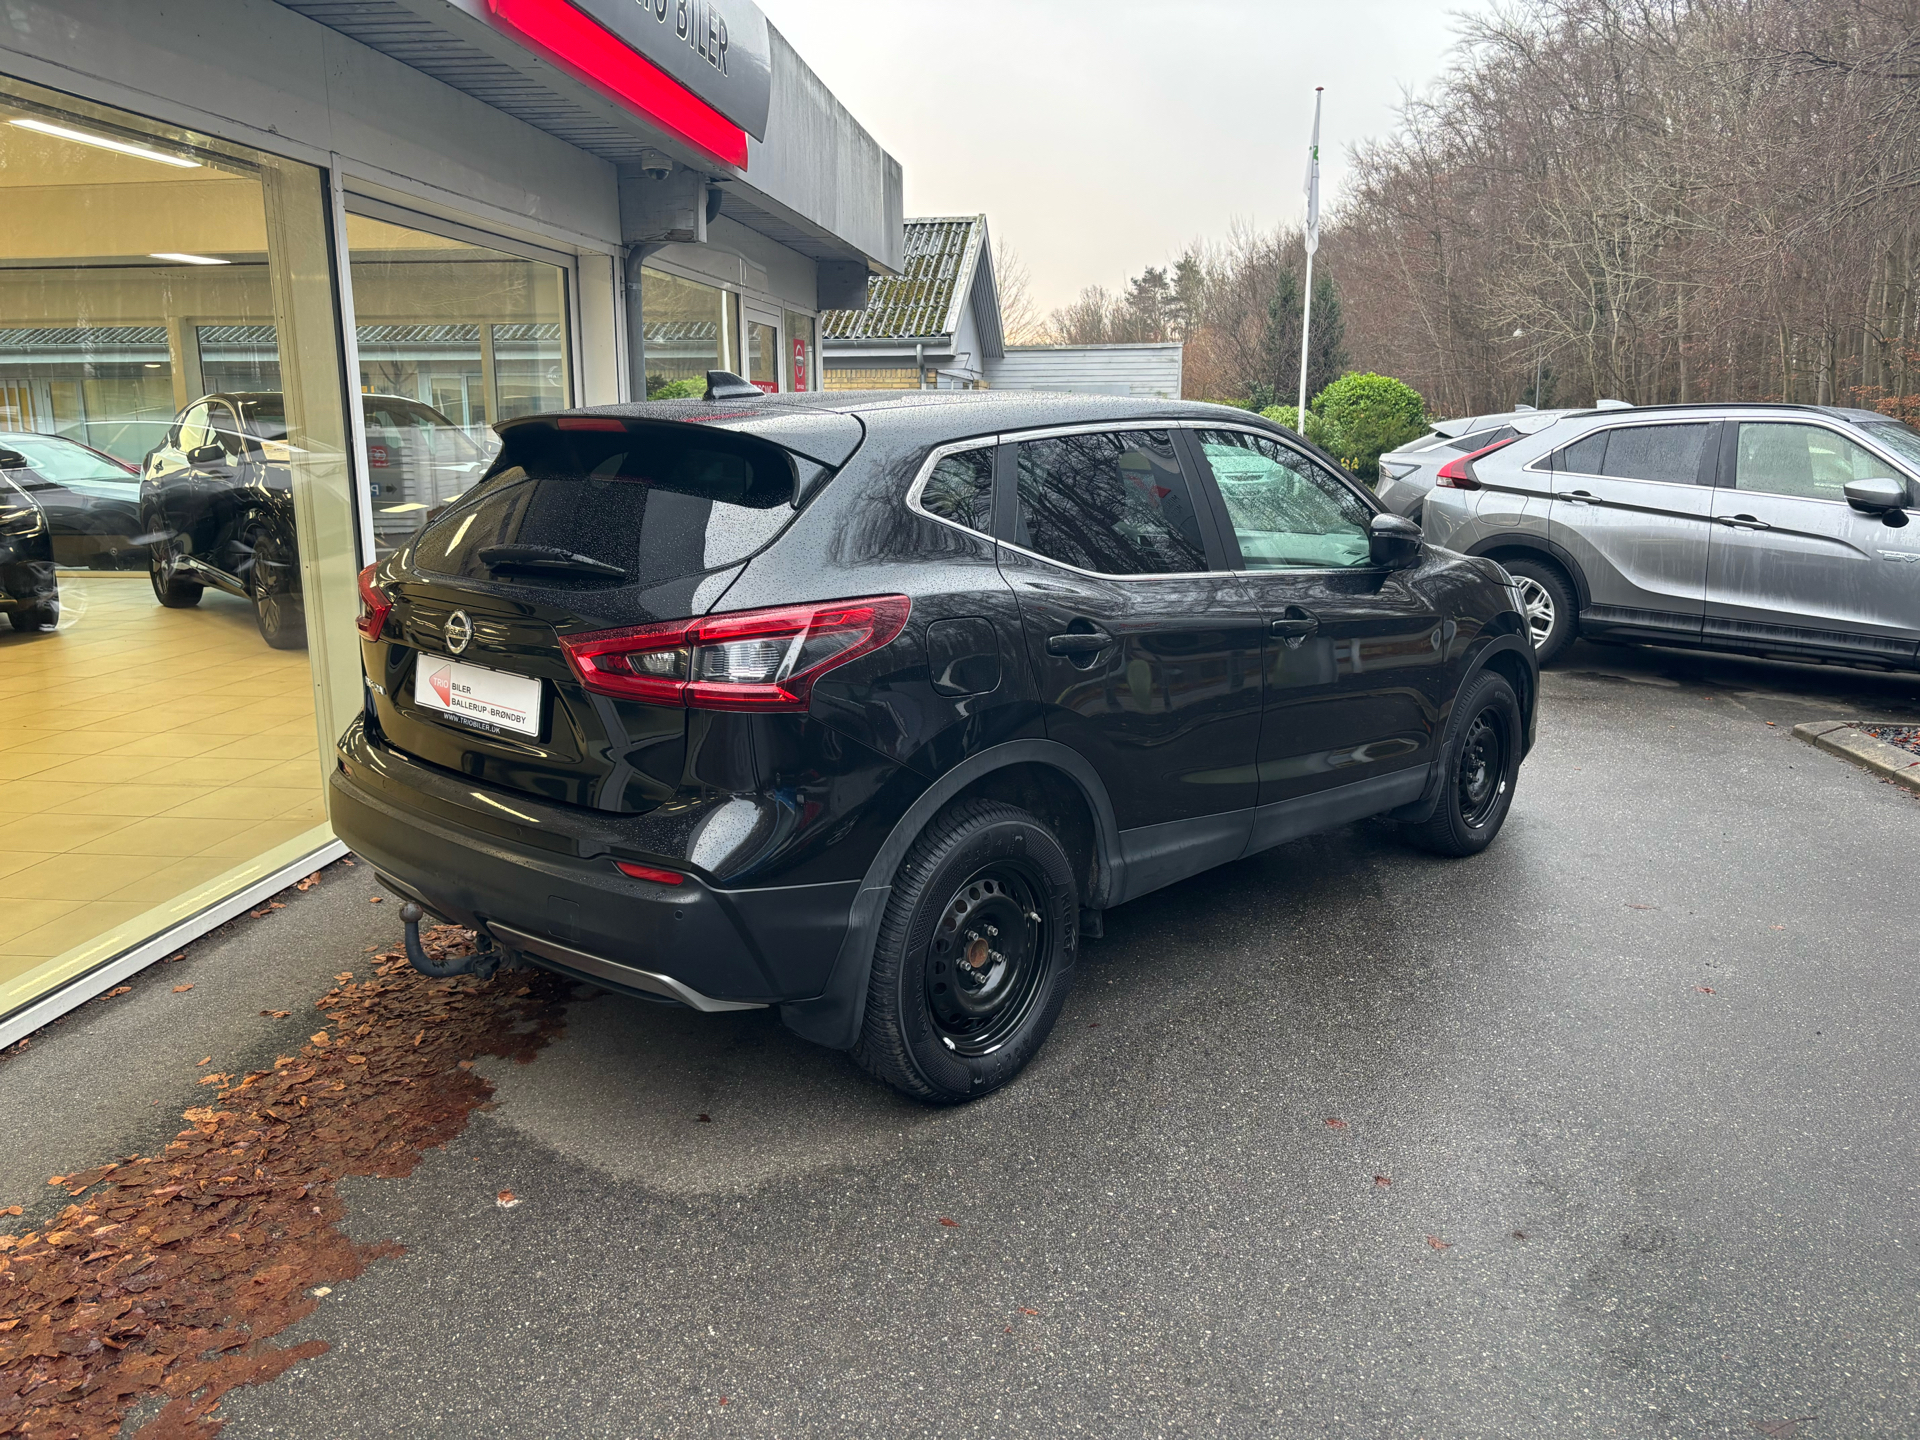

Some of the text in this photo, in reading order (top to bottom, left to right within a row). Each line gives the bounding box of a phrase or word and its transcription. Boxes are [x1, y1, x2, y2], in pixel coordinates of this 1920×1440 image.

[675, 0, 730, 77] BILER
[433, 677, 449, 689] TRIO
[451, 682, 472, 695] BILER
[451, 697, 527, 725] BALLERUP BRØNDBY
[443, 712, 502, 734] WWW.TRIOBILER.DK
